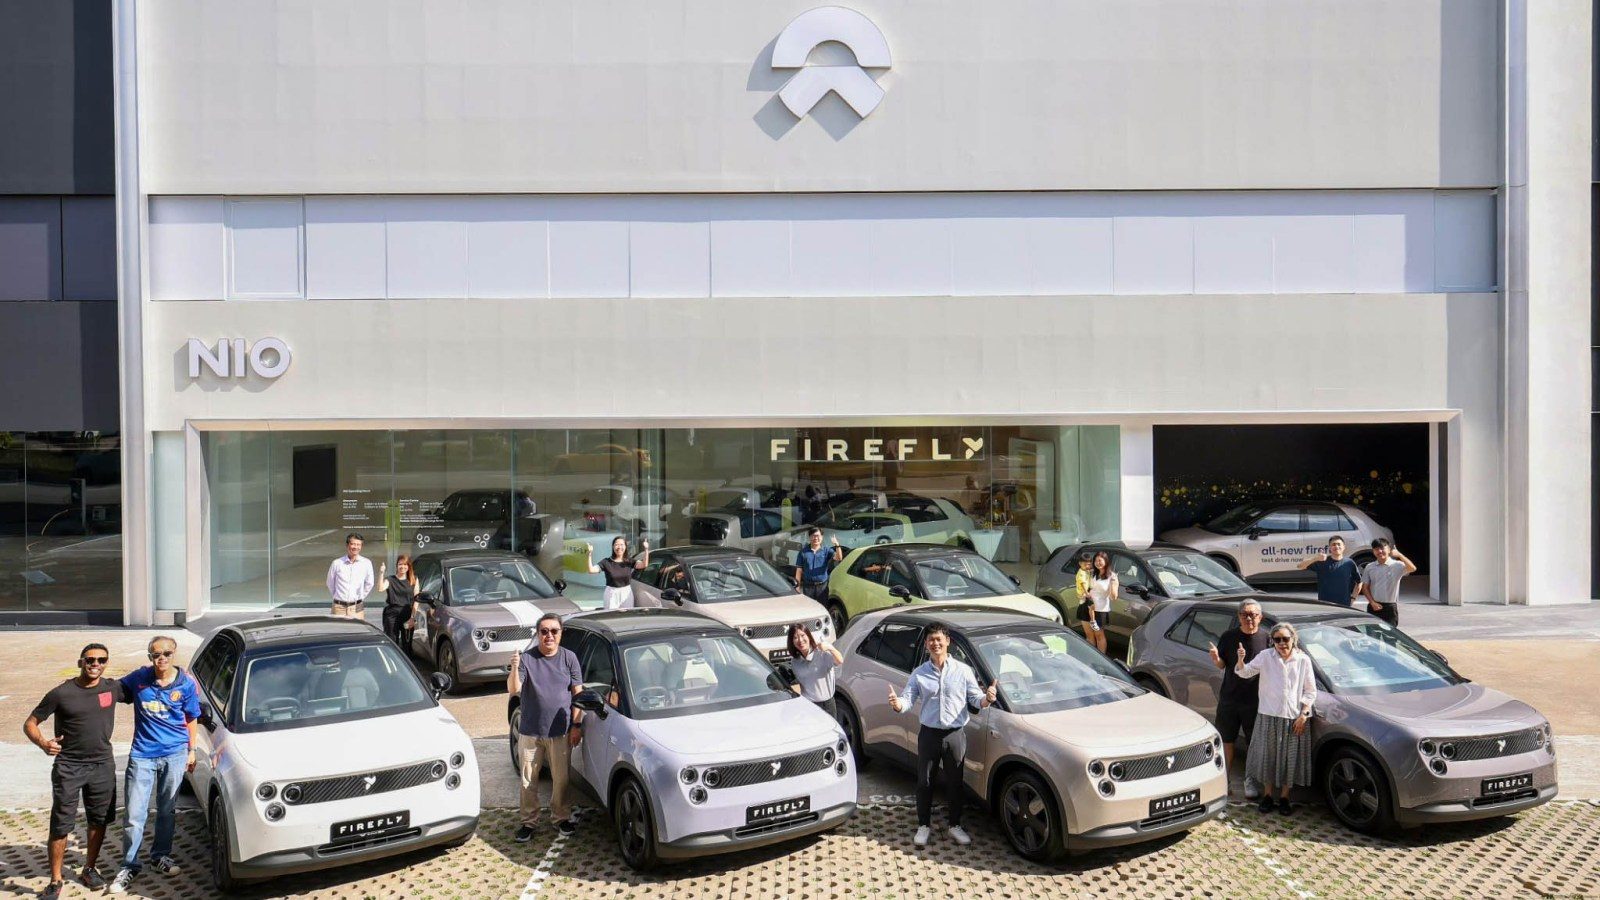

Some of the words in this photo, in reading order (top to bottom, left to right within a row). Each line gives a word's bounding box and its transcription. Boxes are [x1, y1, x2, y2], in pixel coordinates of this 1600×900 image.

[187, 337, 291, 378] NIO
[770, 437, 984, 461] FIREFLY
[1261, 546, 1303, 556] all-new
[1305, 545, 1331, 555] firef
[1488, 777, 1528, 790] FIREFLY
[753, 800, 805, 817] FIREFLY
[1155, 793, 1196, 810] FIREFLY
[339, 815, 403, 834] FIREFLY
